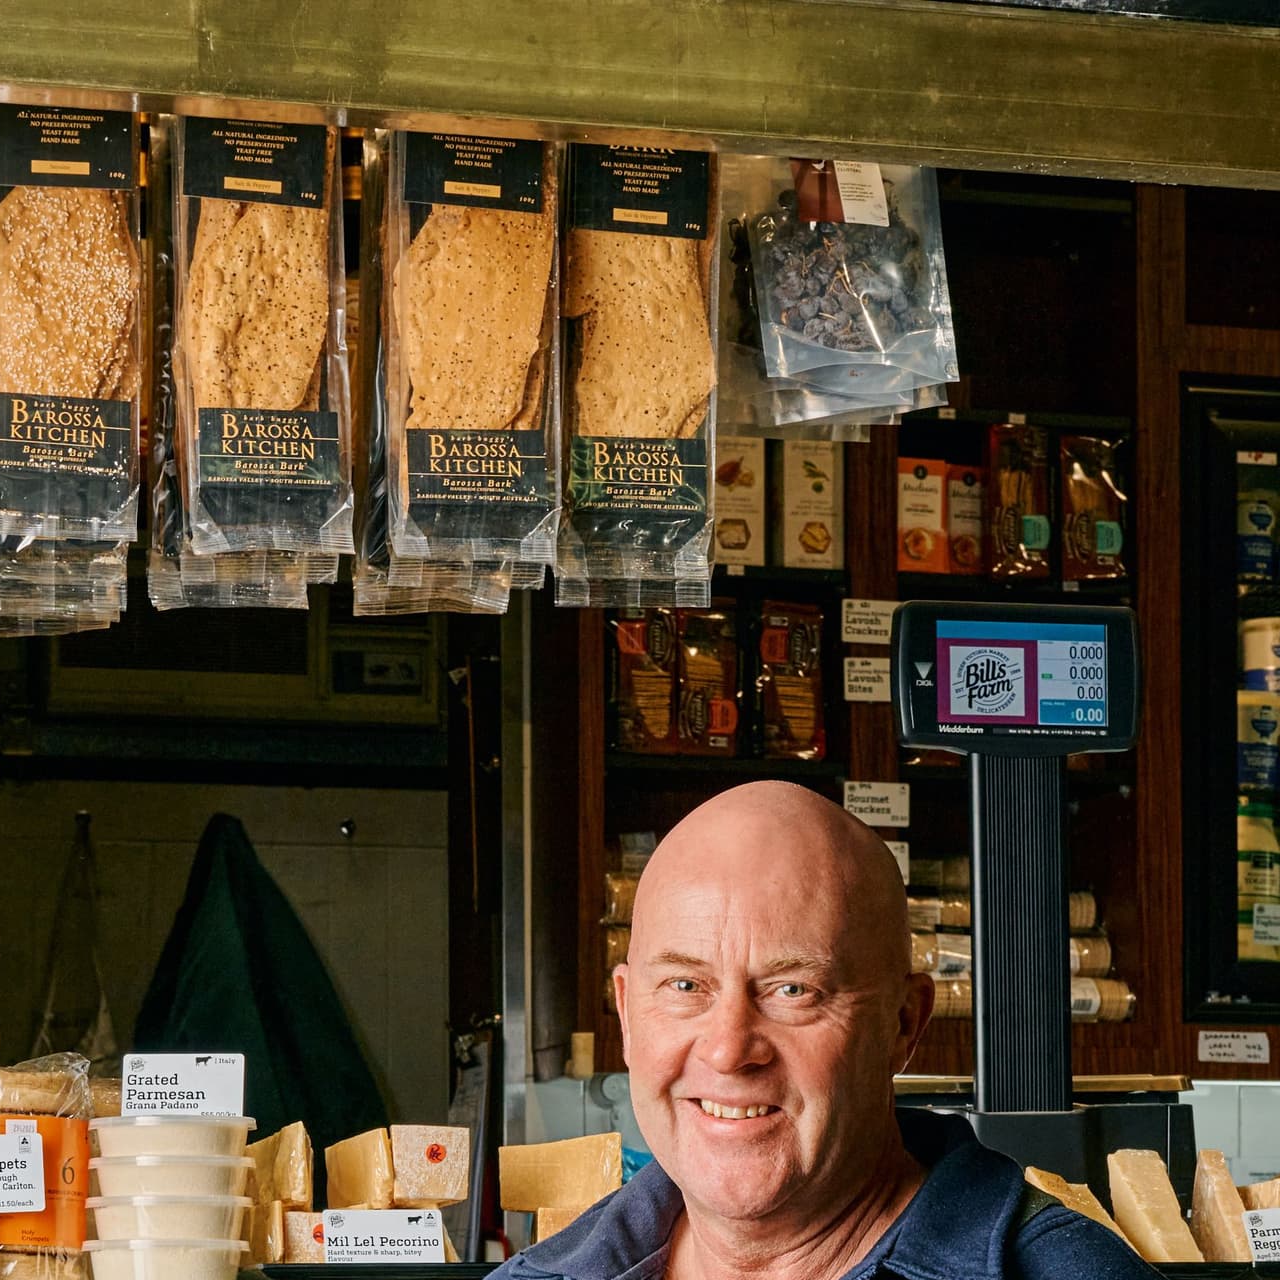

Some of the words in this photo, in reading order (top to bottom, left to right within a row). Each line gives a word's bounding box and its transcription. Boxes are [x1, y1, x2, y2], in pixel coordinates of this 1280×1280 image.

[11, 399, 104, 428] BAROSSA
[221, 413, 313, 439] BAROSSA
[10, 425, 105, 448] KITCHEN
[222, 439, 315, 460] KITCHEN
[429, 435, 520, 458] BAROSSA
[593, 442, 681, 466] BAROSSA
[430, 459, 522, 477] KITCHEN
[594, 467, 683, 485] KITCHEN
[845, 616, 881, 625] Lavosh
[845, 626, 889, 636] Crackers
[1070, 646, 1103, 659] 0.000
[847, 674, 884, 683] Lavosh
[966, 658, 1006, 688] Bill's
[1070, 666, 1103, 680] 0.000
[848, 684, 873, 693] Bites
[968, 680, 1013, 709] Farm
[1078, 687, 1103, 699] 0.00
[938, 724, 984, 734] Wedderburn
[847, 795, 889, 803] Gourmet
[128, 1074, 178, 1085] Grated
[127, 1089, 206, 1100] Parmesan
[62, 1157, 74, 1184] 6
[3, 1182, 35, 1190] Carlton.
[328, 1237, 349, 1246] Mil
[354, 1237, 375, 1246] Lel
[380, 1237, 439, 1246] Pecorino
